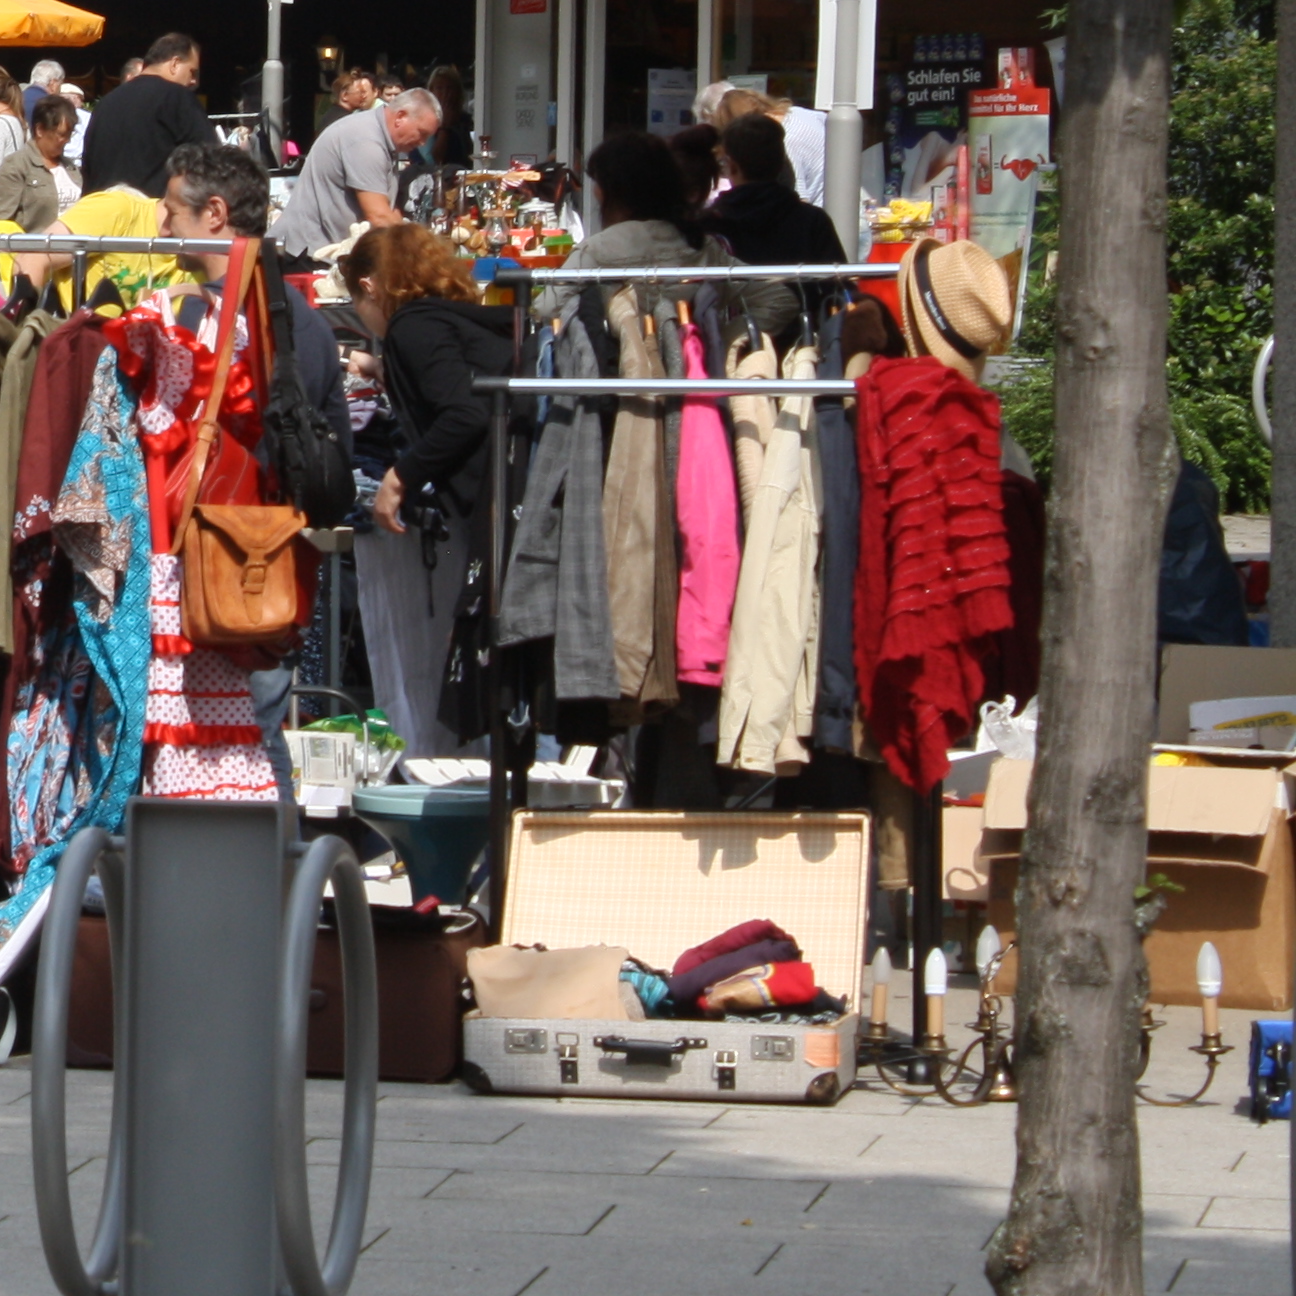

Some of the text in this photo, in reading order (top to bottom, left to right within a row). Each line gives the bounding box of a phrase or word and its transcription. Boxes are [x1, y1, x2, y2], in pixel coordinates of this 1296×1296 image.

[908, 68, 982, 85] Schlafen Sie
[908, 86, 955, 106] gut ein!
[1018, 104, 1039, 112] Herz
